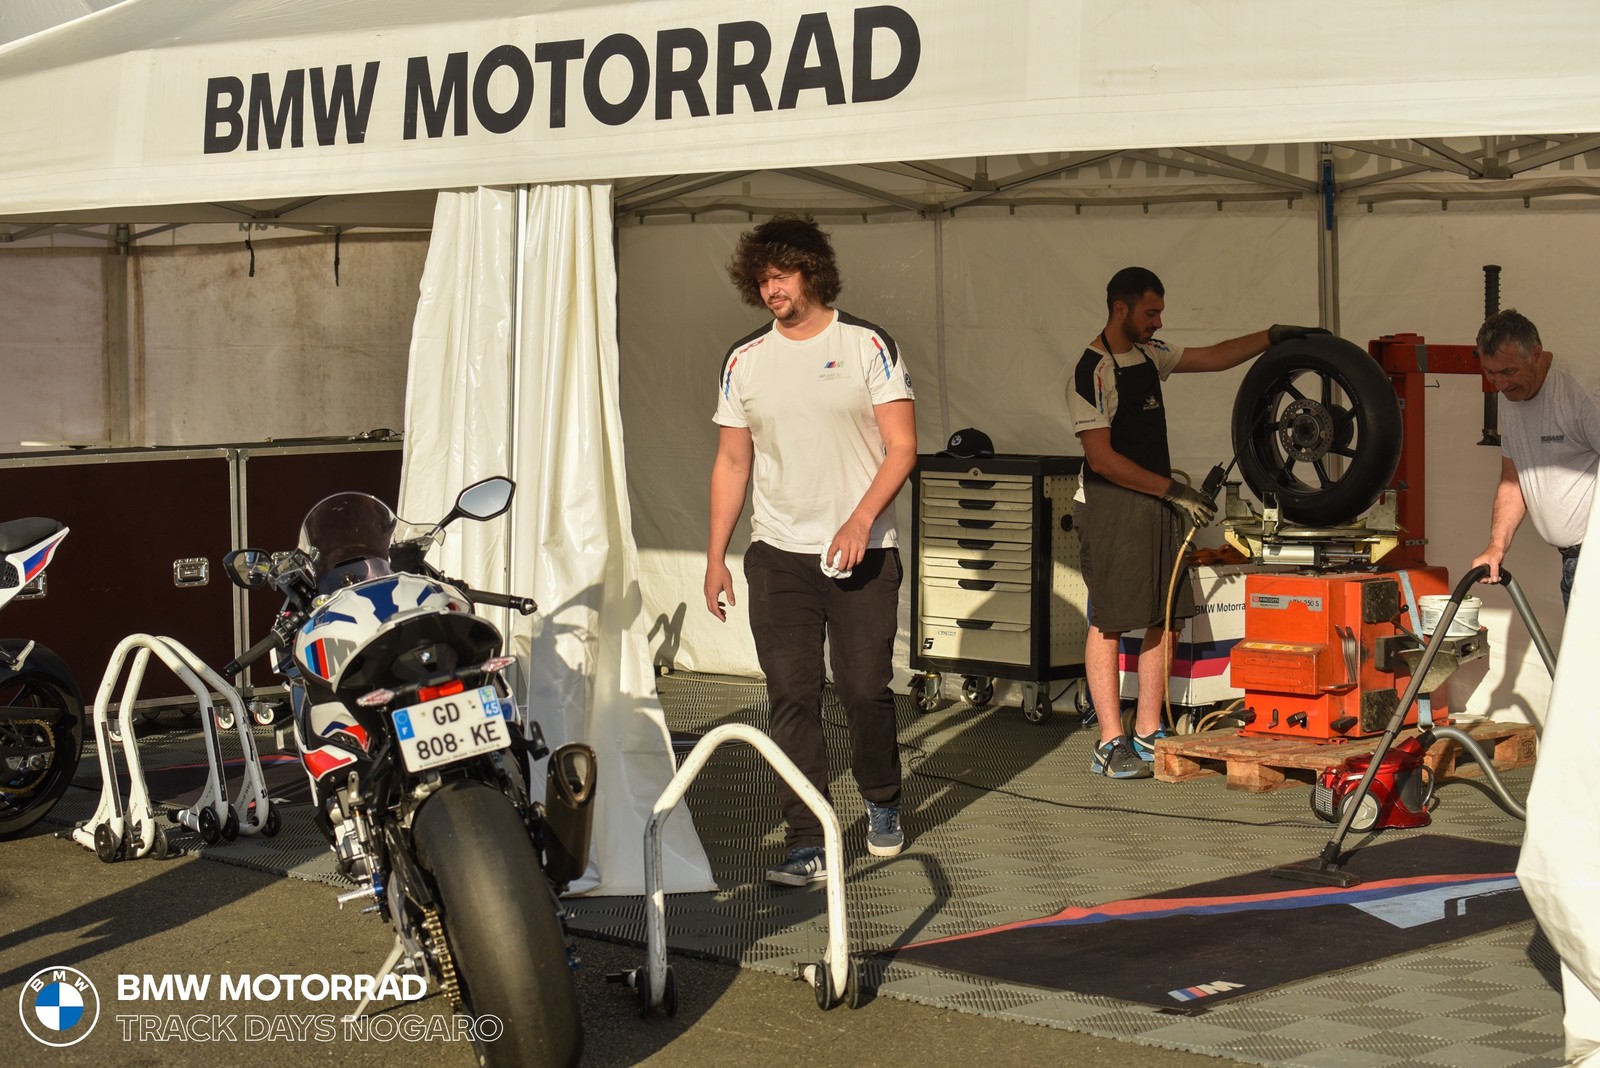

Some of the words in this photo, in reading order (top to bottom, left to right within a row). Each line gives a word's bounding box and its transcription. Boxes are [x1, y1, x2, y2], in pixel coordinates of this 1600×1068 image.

[203, 61, 380, 155] BMW
[402, 5, 921, 141] MOTORRAD
[1195, 604, 1215, 615] BMW
[1217, 602, 1246, 613] Motorra
[433, 702, 460, 726] GD
[485, 703, 499, 715] 45
[402, 727, 408, 735] F
